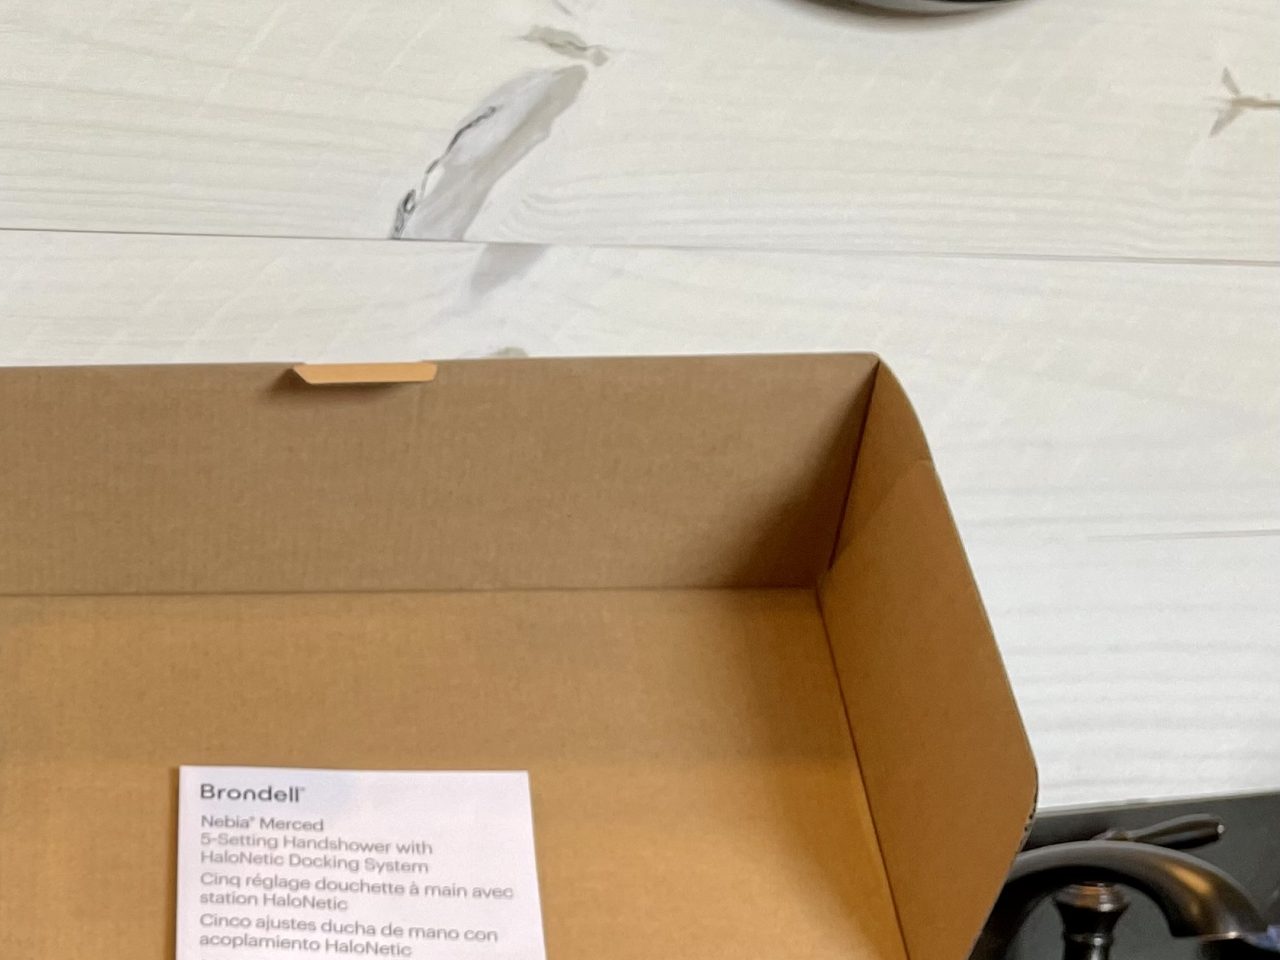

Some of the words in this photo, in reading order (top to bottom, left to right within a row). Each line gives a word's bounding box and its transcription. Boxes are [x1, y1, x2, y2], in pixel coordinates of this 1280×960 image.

[200, 784, 300, 803] Brondell
[260, 817, 324, 832] Merced
[201, 833, 278, 849] 5-Setting
[283, 836, 391, 854] Handshower
[396, 841, 433, 855] with
[201, 851, 283, 866] HaloNetic
[290, 854, 360, 872] Docking
[366, 858, 429, 874] System
[200, 872, 242, 888] Cinq
[246, 873, 310, 891] réglage
[315, 877, 405, 895] douchette
[409, 881, 420, 895] à
[425, 883, 468, 898] main
[472, 886, 514, 899] avec
[200, 891, 258, 906] station
[263, 893, 348, 911] HaloNetic
[200, 914, 252, 929] Cinco
[256, 916, 317, 933] ajustes
[321, 921, 376, 936] ducha
[381, 923, 404, 937] de
[409, 927, 459, 941] mano
[464, 929, 498, 942] con
[199, 934, 320, 951] acoplamiento
[325, 940, 412, 957] HaloNetic
